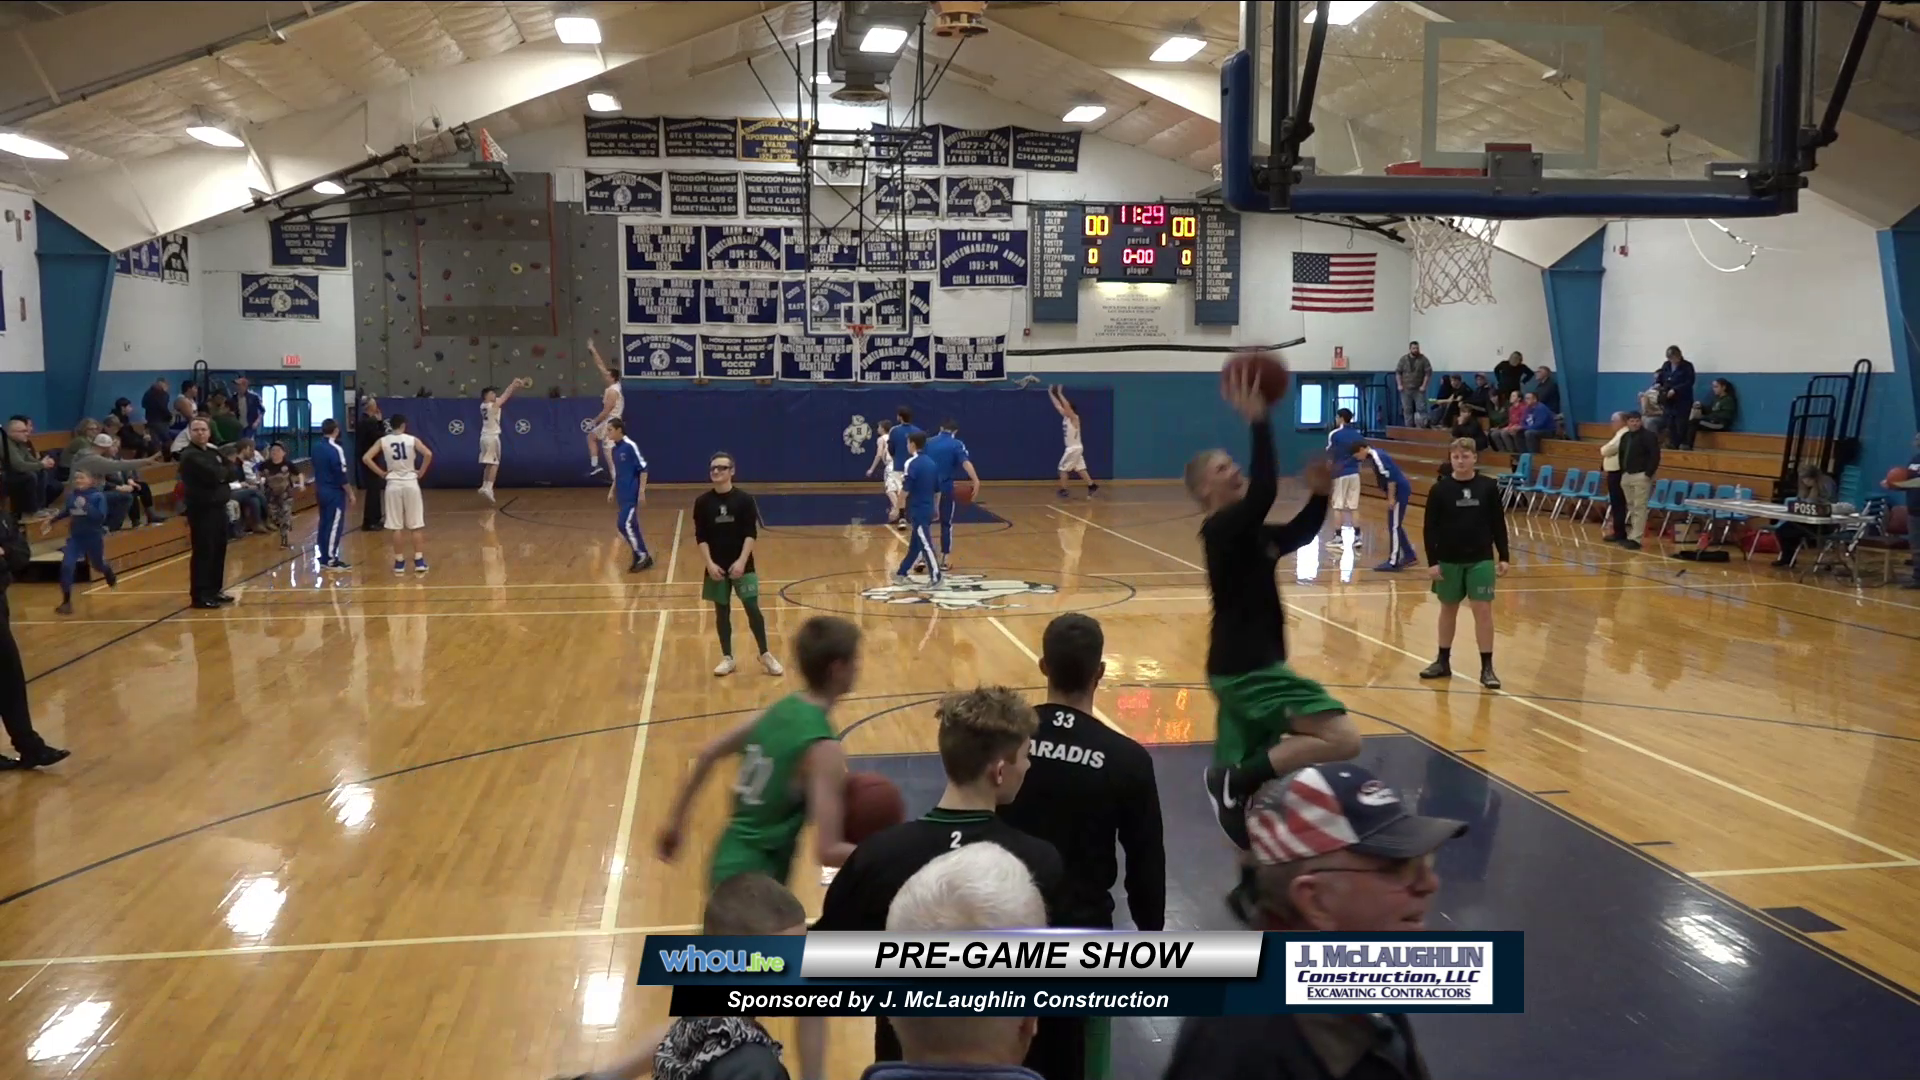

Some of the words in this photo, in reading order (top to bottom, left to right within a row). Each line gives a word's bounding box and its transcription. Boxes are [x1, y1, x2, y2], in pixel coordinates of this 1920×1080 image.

[1017, 154, 1075, 162] CHAMPIONS
[1121, 205, 1164, 224] 11:29
[1085, 215, 1109, 236] 00
[1172, 216, 1196, 237] 00
[957, 232, 982, 241] IAABO
[1127, 237, 1150, 245] period
[1161, 232, 1166, 246] 1
[661, 244, 681, 252] CLASS
[645, 252, 683, 262] BASKETBALL
[872, 252, 890, 260] BOYS
[925, 252, 929, 260] C
[942, 243, 998, 269] SPORTSMANSHIP
[1002, 249, 1025, 267] AWARD
[1088, 248, 1098, 264] 0
[1123, 249, 1154, 264] 0-00
[1181, 249, 1192, 265] 0
[738, 260, 776, 270] BASKETBALL
[1126, 267, 1149, 276] player
[952, 275, 970, 284] GIRLS
[976, 275, 1015, 284] BASKETBALL
[658, 297, 678, 306] CLASS
[910, 295, 929, 314] AWARD
[814, 354, 832, 362] CLASS
[835, 354, 840, 362] C
[891, 371, 925, 380] BASKETBALL
[390, 441, 408, 461] 31
[1052, 711, 1075, 728] 33
[1029, 739, 1105, 769] ARADIS
[950, 830, 962, 848] 2
